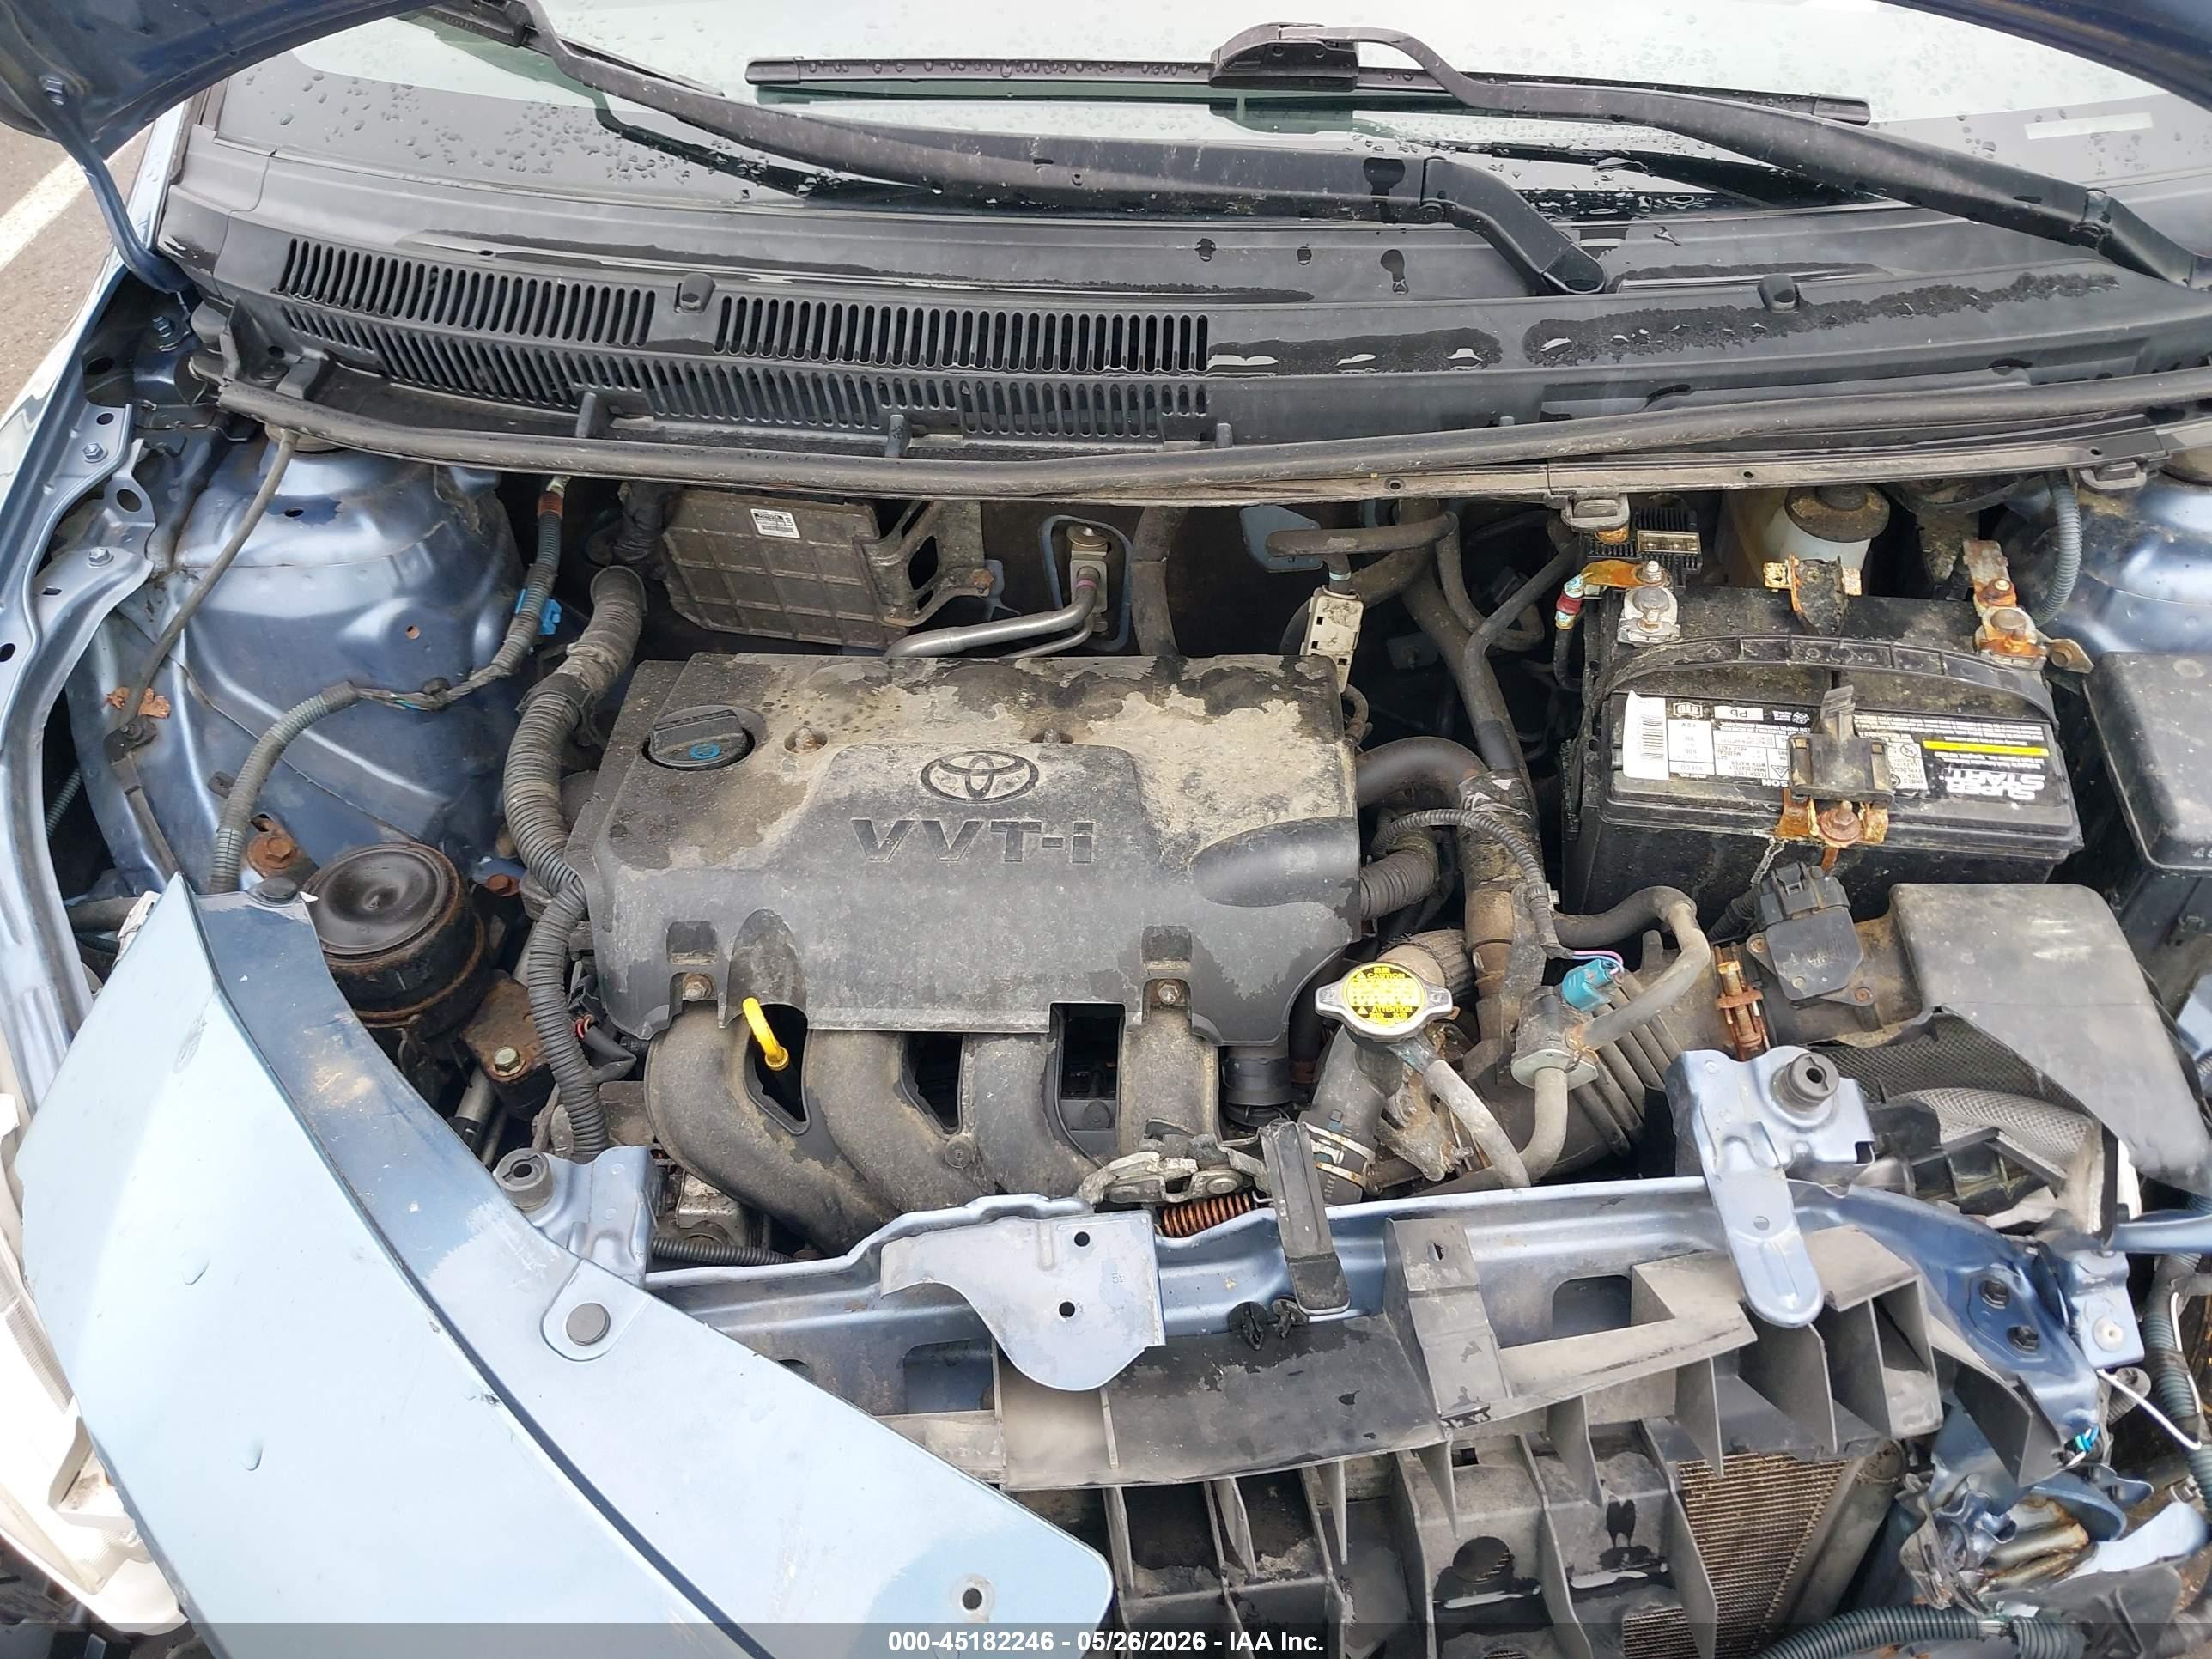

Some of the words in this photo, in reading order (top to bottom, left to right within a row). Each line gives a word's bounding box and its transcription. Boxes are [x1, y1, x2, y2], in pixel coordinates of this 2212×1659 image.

[1729, 709, 1748, 718] Pb
[1761, 778, 1789, 788] SON
[1944, 769, 2045, 791] START
[1946, 781, 2035, 800] SUPER
[851, 819, 1094, 864] VVT-i
